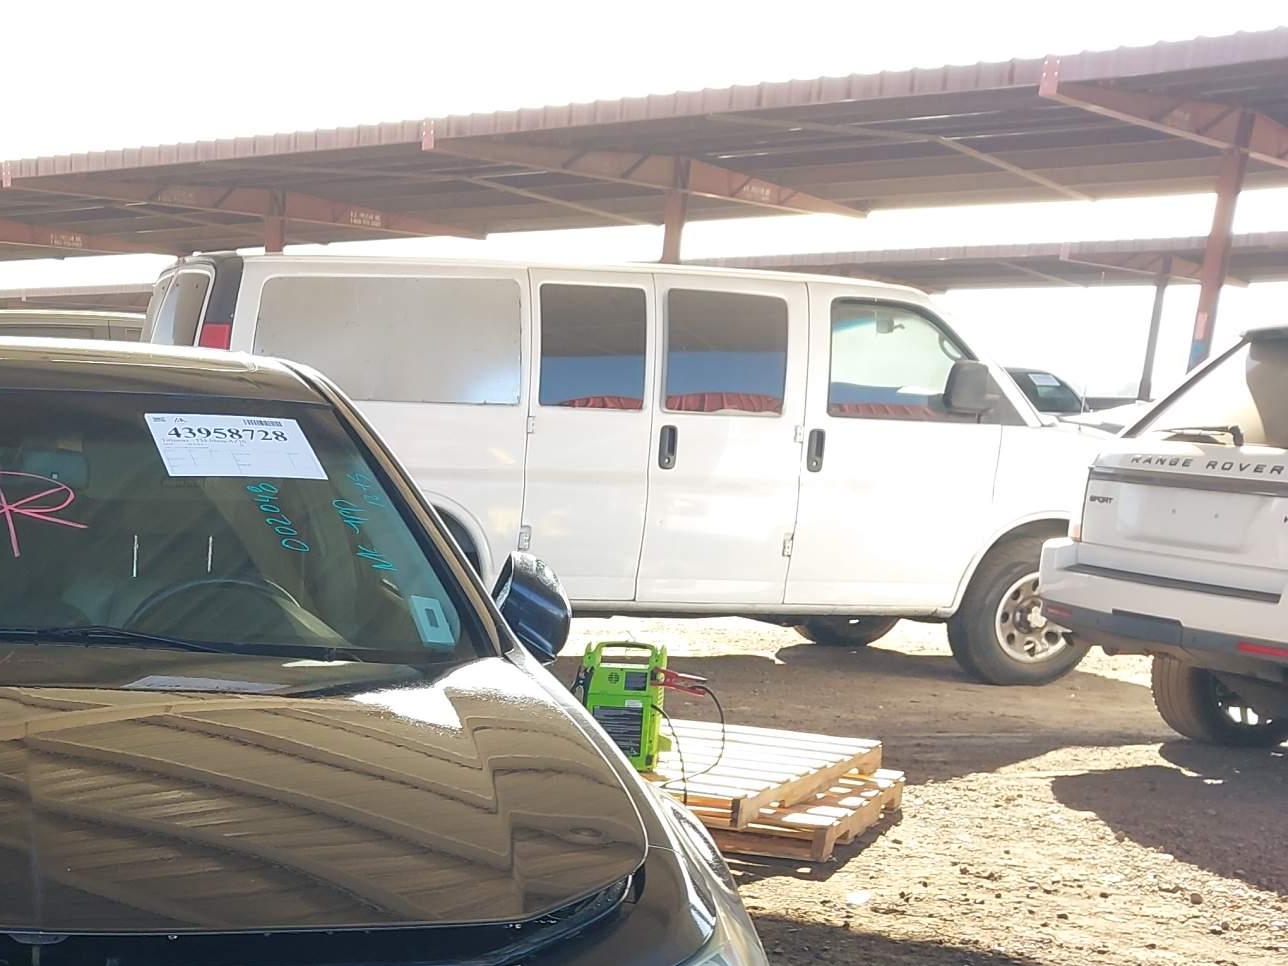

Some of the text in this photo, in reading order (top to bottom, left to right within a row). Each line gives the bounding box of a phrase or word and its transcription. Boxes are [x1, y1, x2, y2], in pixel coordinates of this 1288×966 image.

[167, 426, 288, 442] 43958728
[1130, 455, 1286, 475] RANGE ROVER
